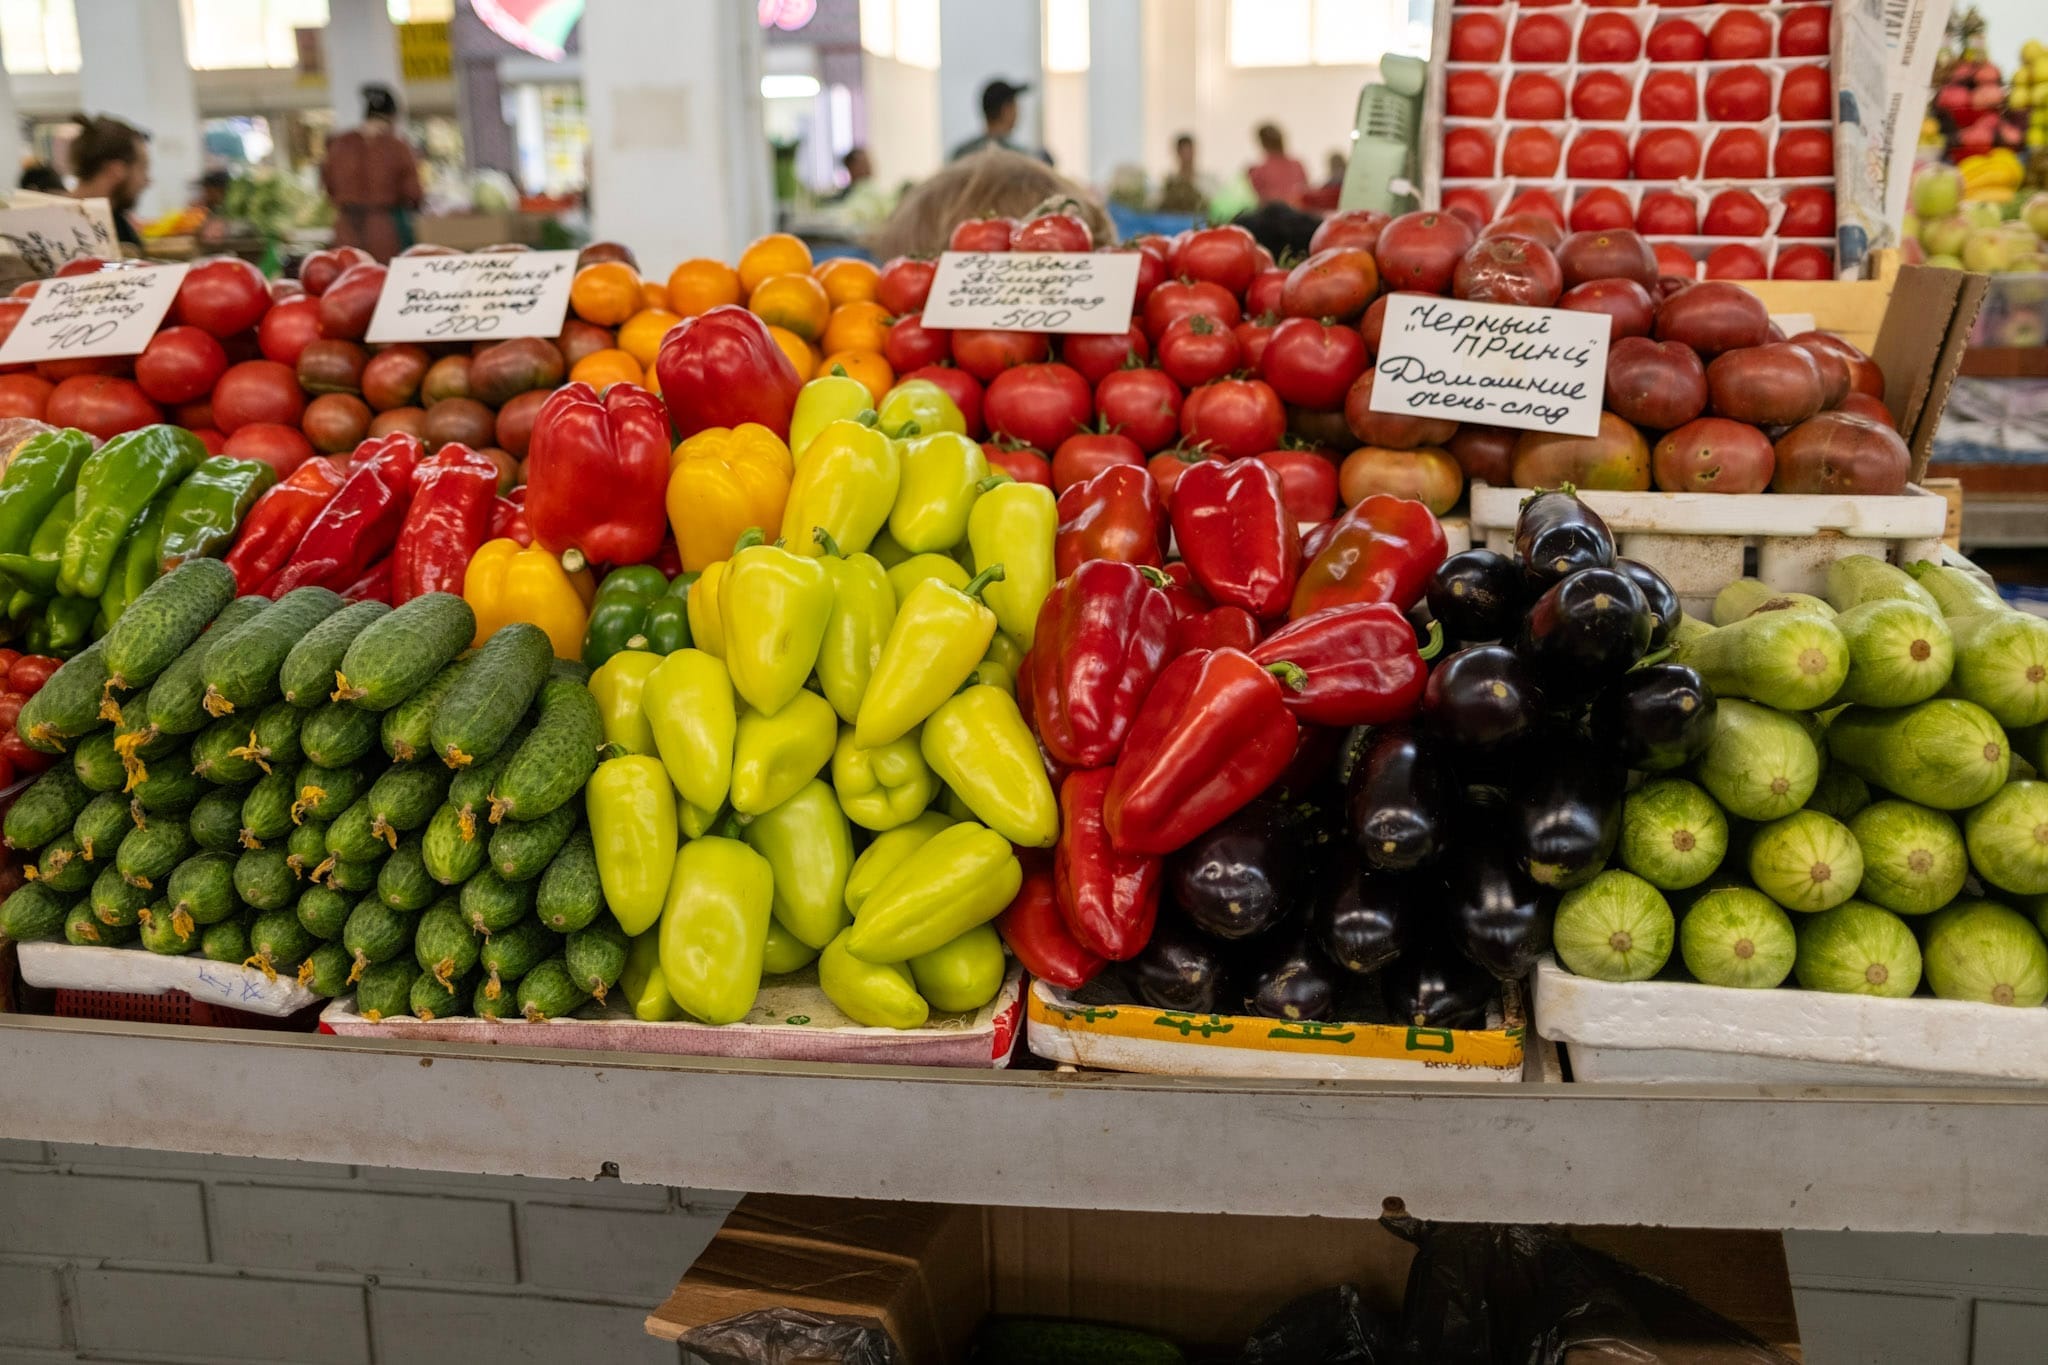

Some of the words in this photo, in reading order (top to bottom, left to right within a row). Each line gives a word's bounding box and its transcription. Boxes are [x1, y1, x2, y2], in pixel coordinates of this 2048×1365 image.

[426, 315, 500, 336] 500
[992, 309, 1071, 328] 500
[48, 320, 118, 349] 400
[1380, 356, 1587, 400] Домашние
